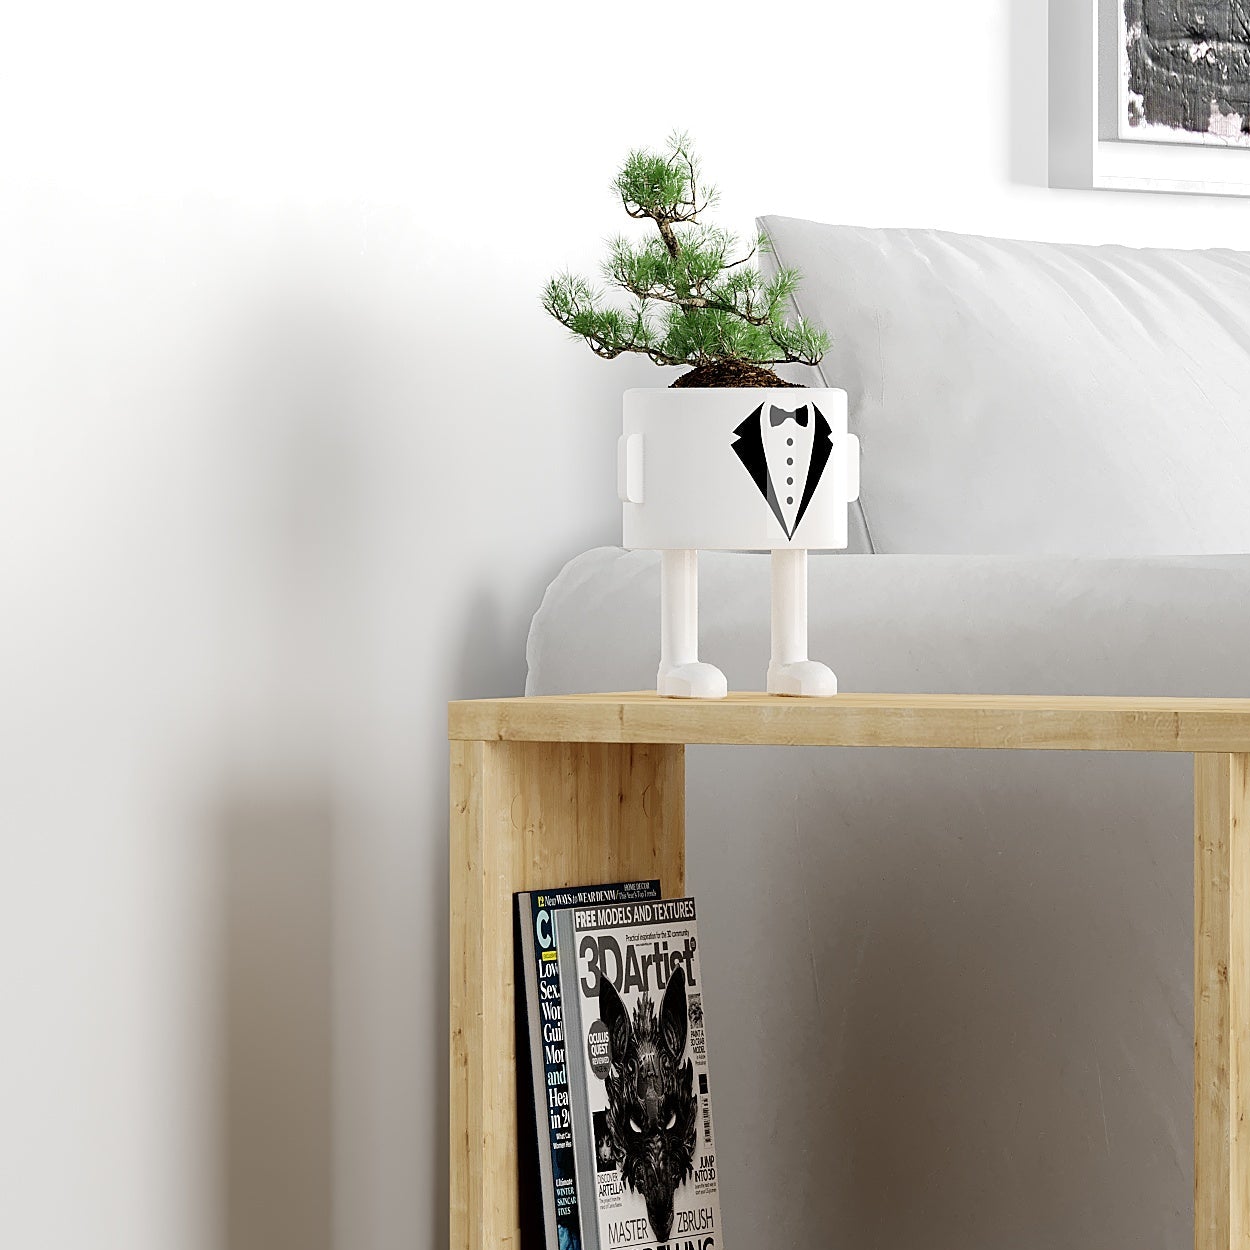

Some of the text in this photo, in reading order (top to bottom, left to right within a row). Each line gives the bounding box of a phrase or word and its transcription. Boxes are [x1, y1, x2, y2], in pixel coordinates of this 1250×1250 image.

[575, 900, 694, 929] FREE MODELS AND TEXTURES
[591, 1043, 609, 1057] QUEST
[547, 1064, 567, 1086] and
[550, 1109, 561, 1129] in
[700, 1155, 714, 1168] JUMP
[708, 1168, 715, 1181] 3D
[556, 1187, 575, 1196] WINTER
[599, 1181, 623, 1197] ARTELLA
[608, 1207, 714, 1244] MASTER ZBRUSH
